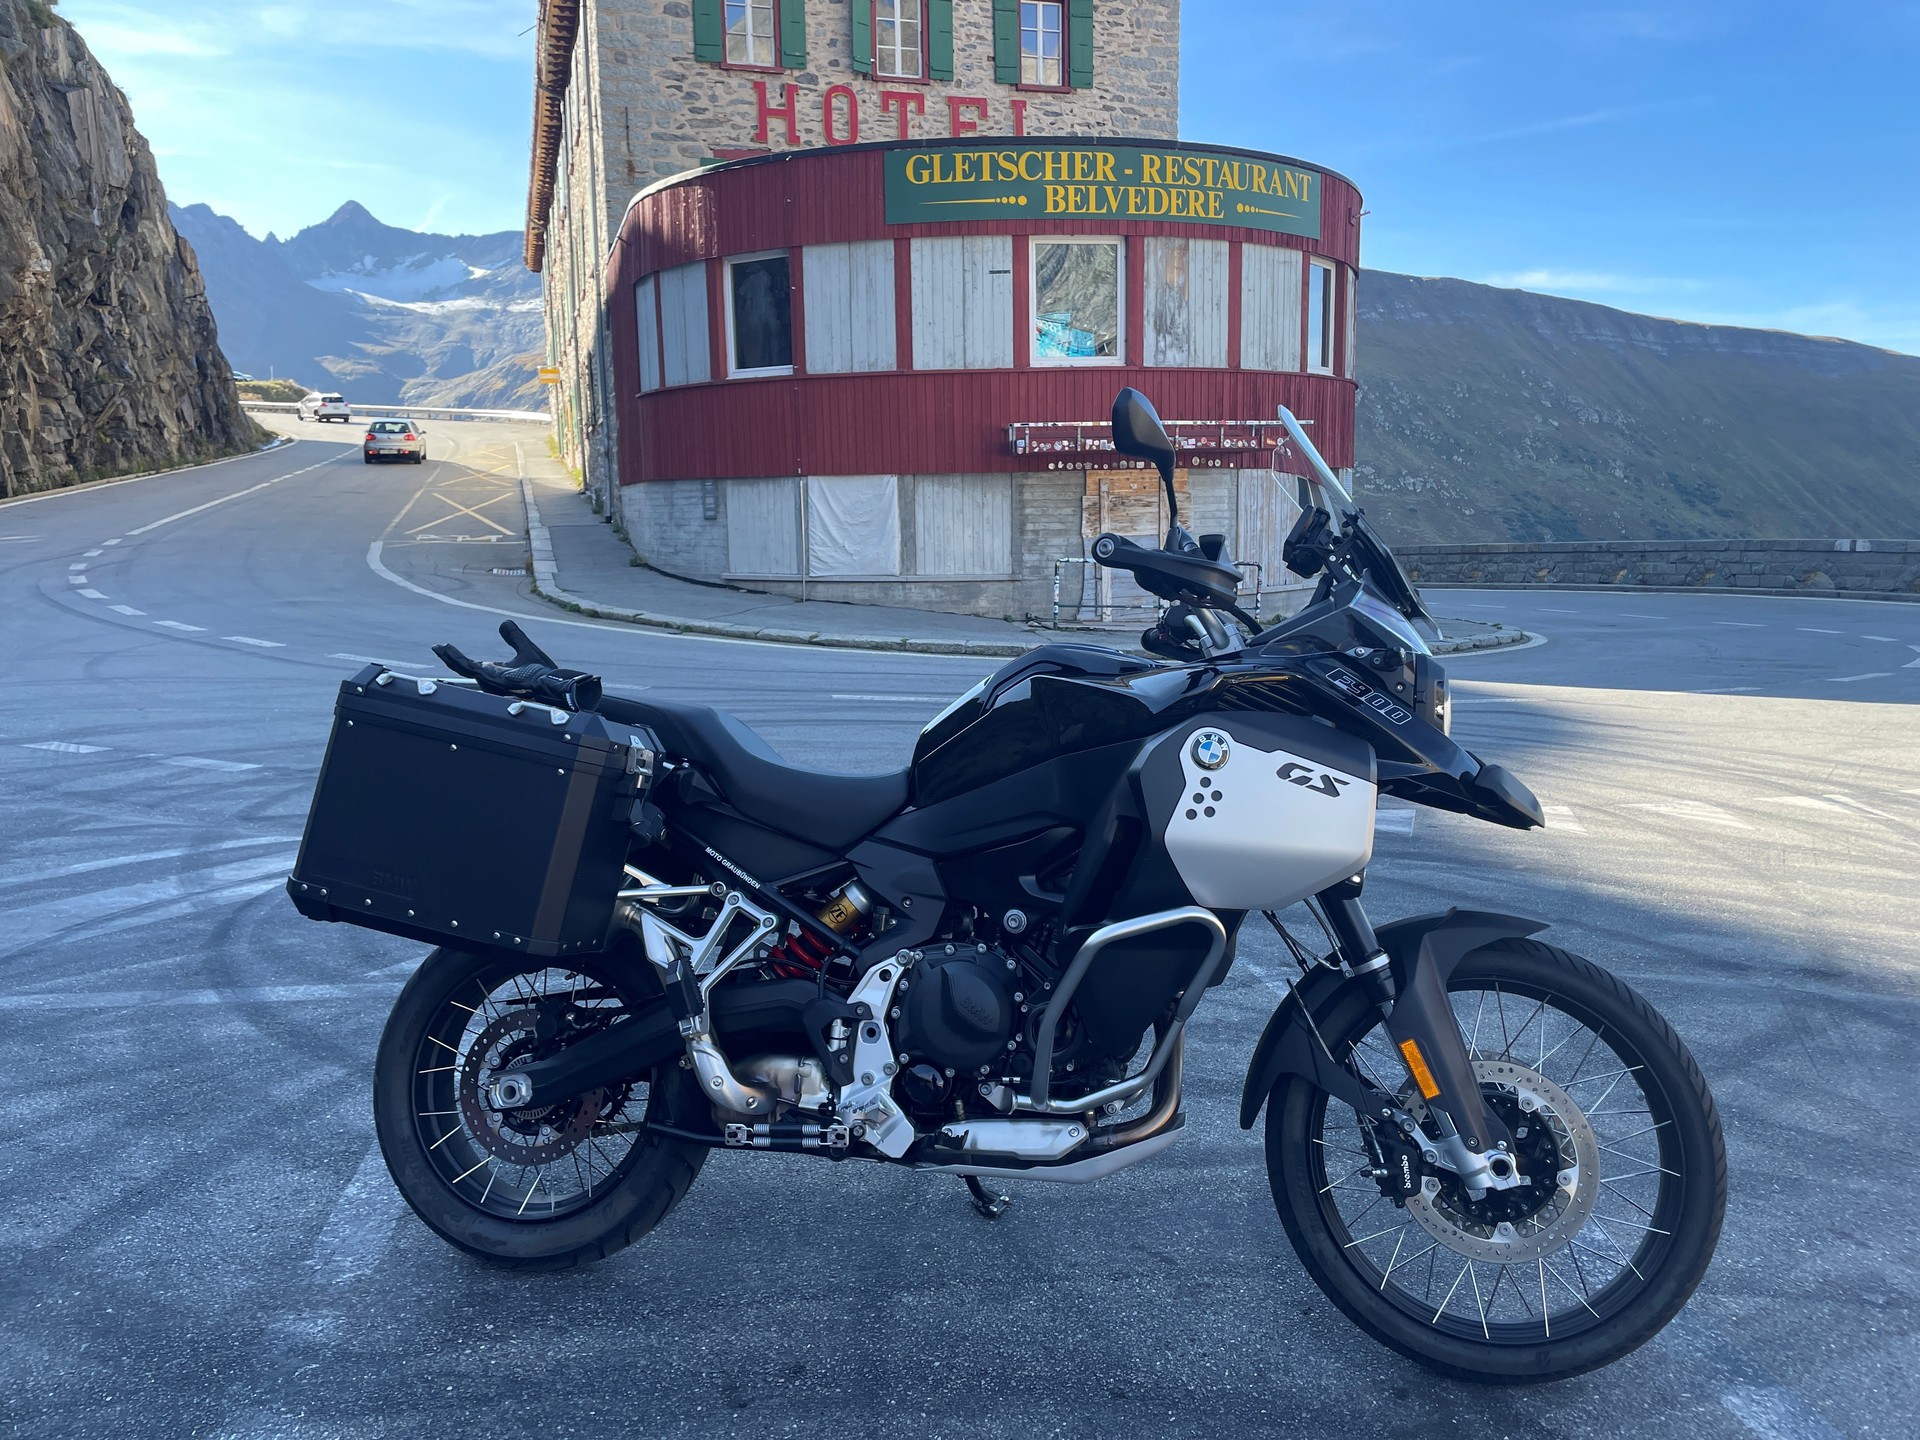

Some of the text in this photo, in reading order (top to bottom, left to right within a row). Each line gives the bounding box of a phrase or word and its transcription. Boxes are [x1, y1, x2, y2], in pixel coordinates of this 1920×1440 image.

[905, 151, 1117, 185] GLETSCHER
[1140, 153, 1312, 202] RESTAURANT
[1043, 184, 1225, 219] BELVEDERE
[1325, 667, 1412, 726] F900
[1276, 762, 1350, 798] GS
[705, 846, 761, 889] MOTO GRAUBÜNDEN
[829, 904, 848, 923] ZF
[960, 997, 993, 1026] BMW
[1400, 1154, 1412, 1189] brembo
